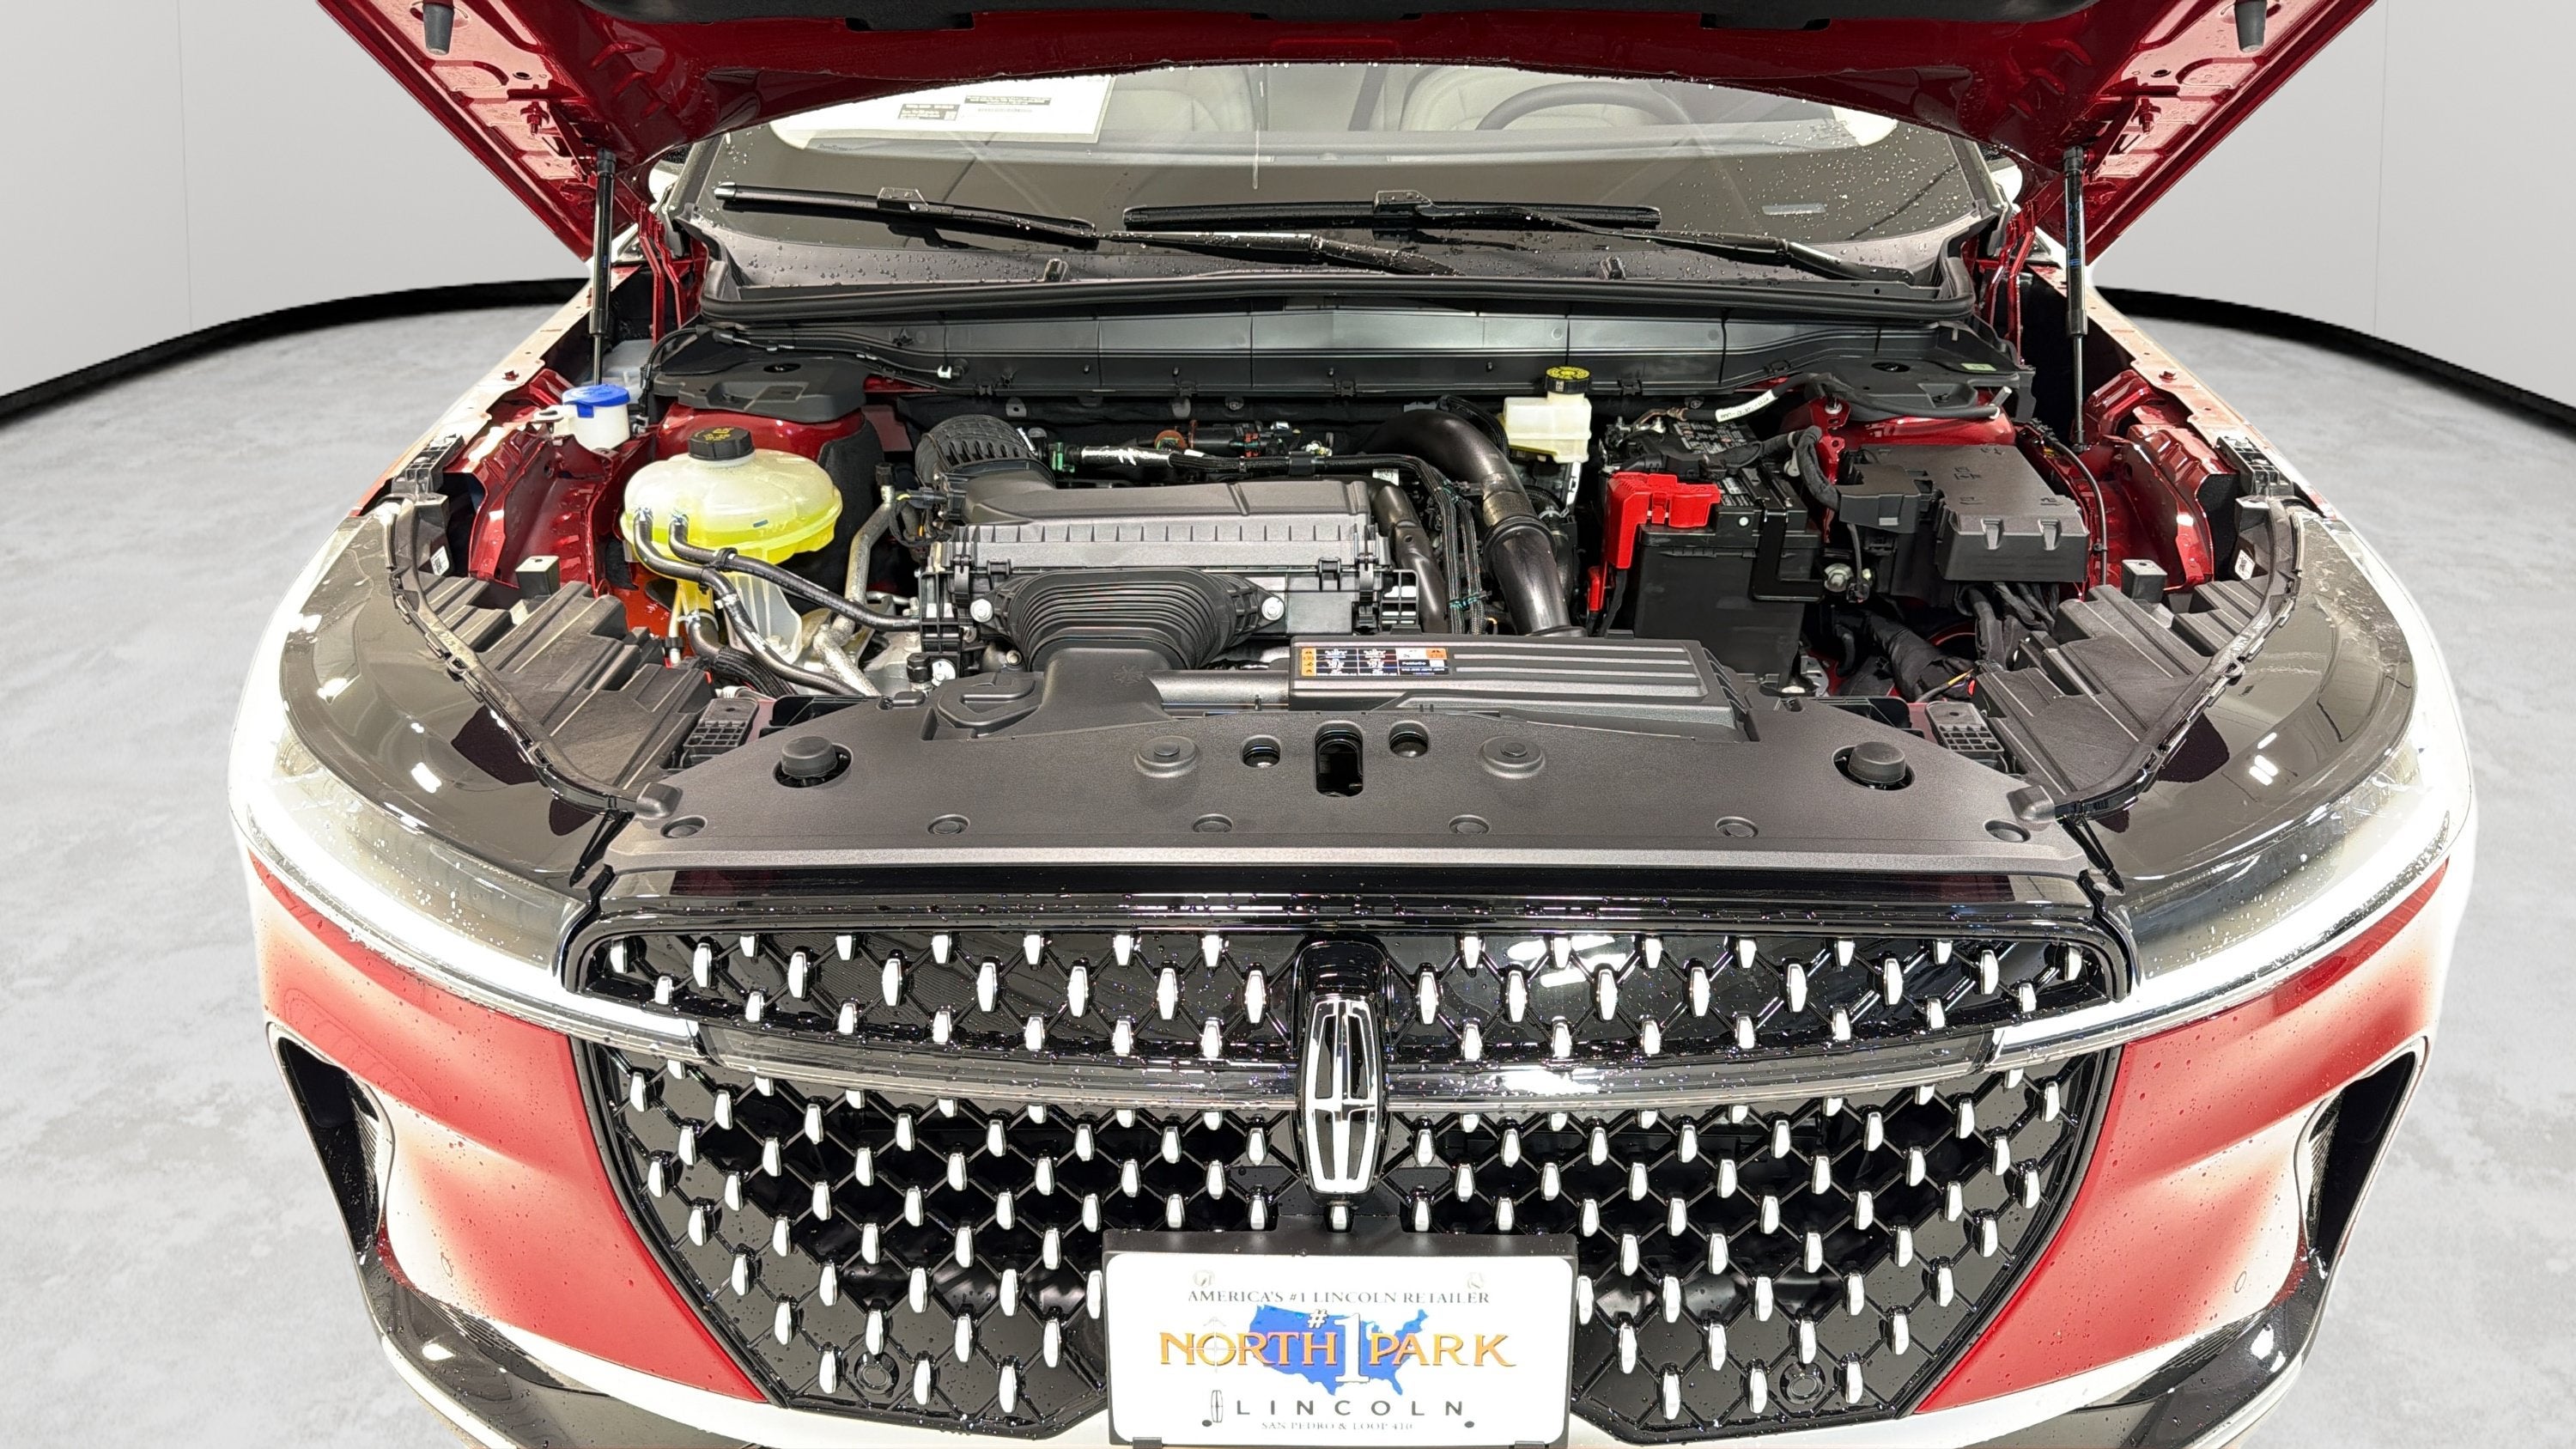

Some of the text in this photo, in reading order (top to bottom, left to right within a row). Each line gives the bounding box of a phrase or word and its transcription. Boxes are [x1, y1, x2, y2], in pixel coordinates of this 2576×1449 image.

[1188, 1291, 1490, 1304] AMERICA'S #1 LINCOLN RETAILER
[1159, 1330, 1518, 1367] NORTH PARK
[1236, 1399, 1464, 1416] LINCOLN
[1261, 1422, 1286, 1430] SAN
[1291, 1422, 1334, 1430] PEDRO
